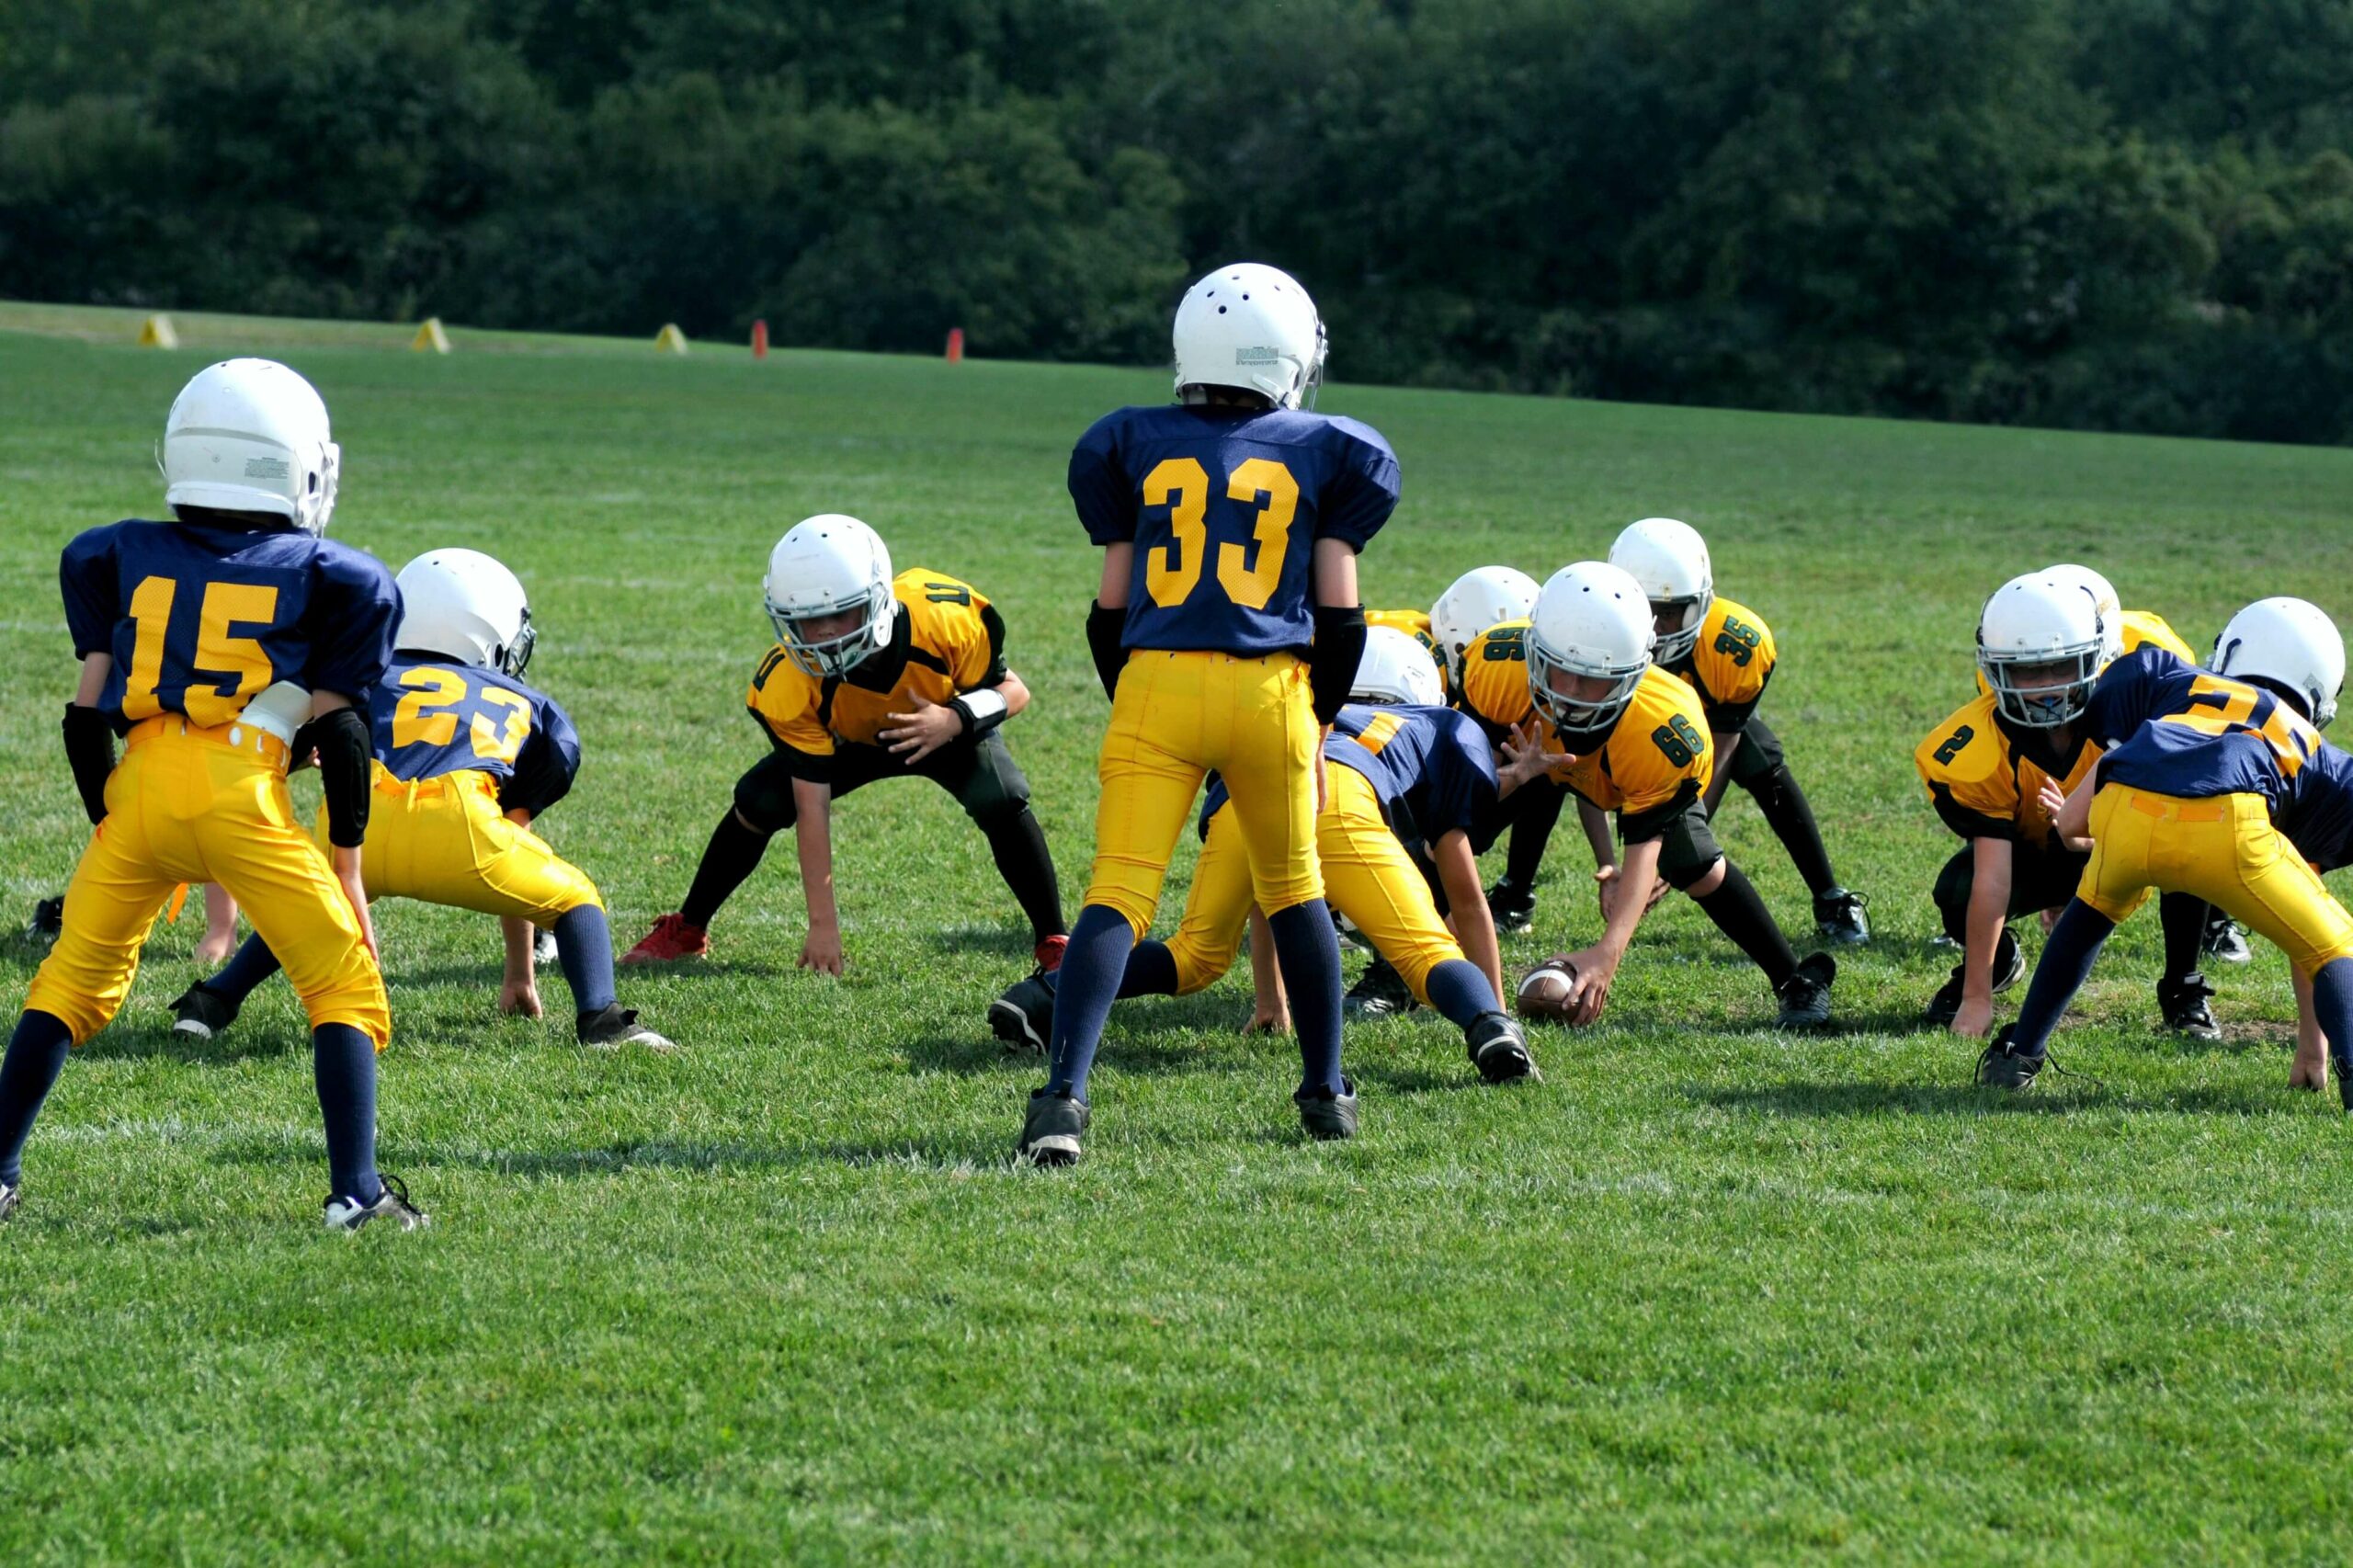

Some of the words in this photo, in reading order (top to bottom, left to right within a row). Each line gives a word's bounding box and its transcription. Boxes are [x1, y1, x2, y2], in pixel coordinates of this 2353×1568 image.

[1142, 457, 1300, 609] 33
[925, 583, 971, 607] 11
[123, 575, 278, 728] 15
[1714, 615, 1761, 667] 35
[392, 666, 530, 764] 23
[1652, 713, 1704, 767] 66
[1933, 724, 1974, 767] 2
